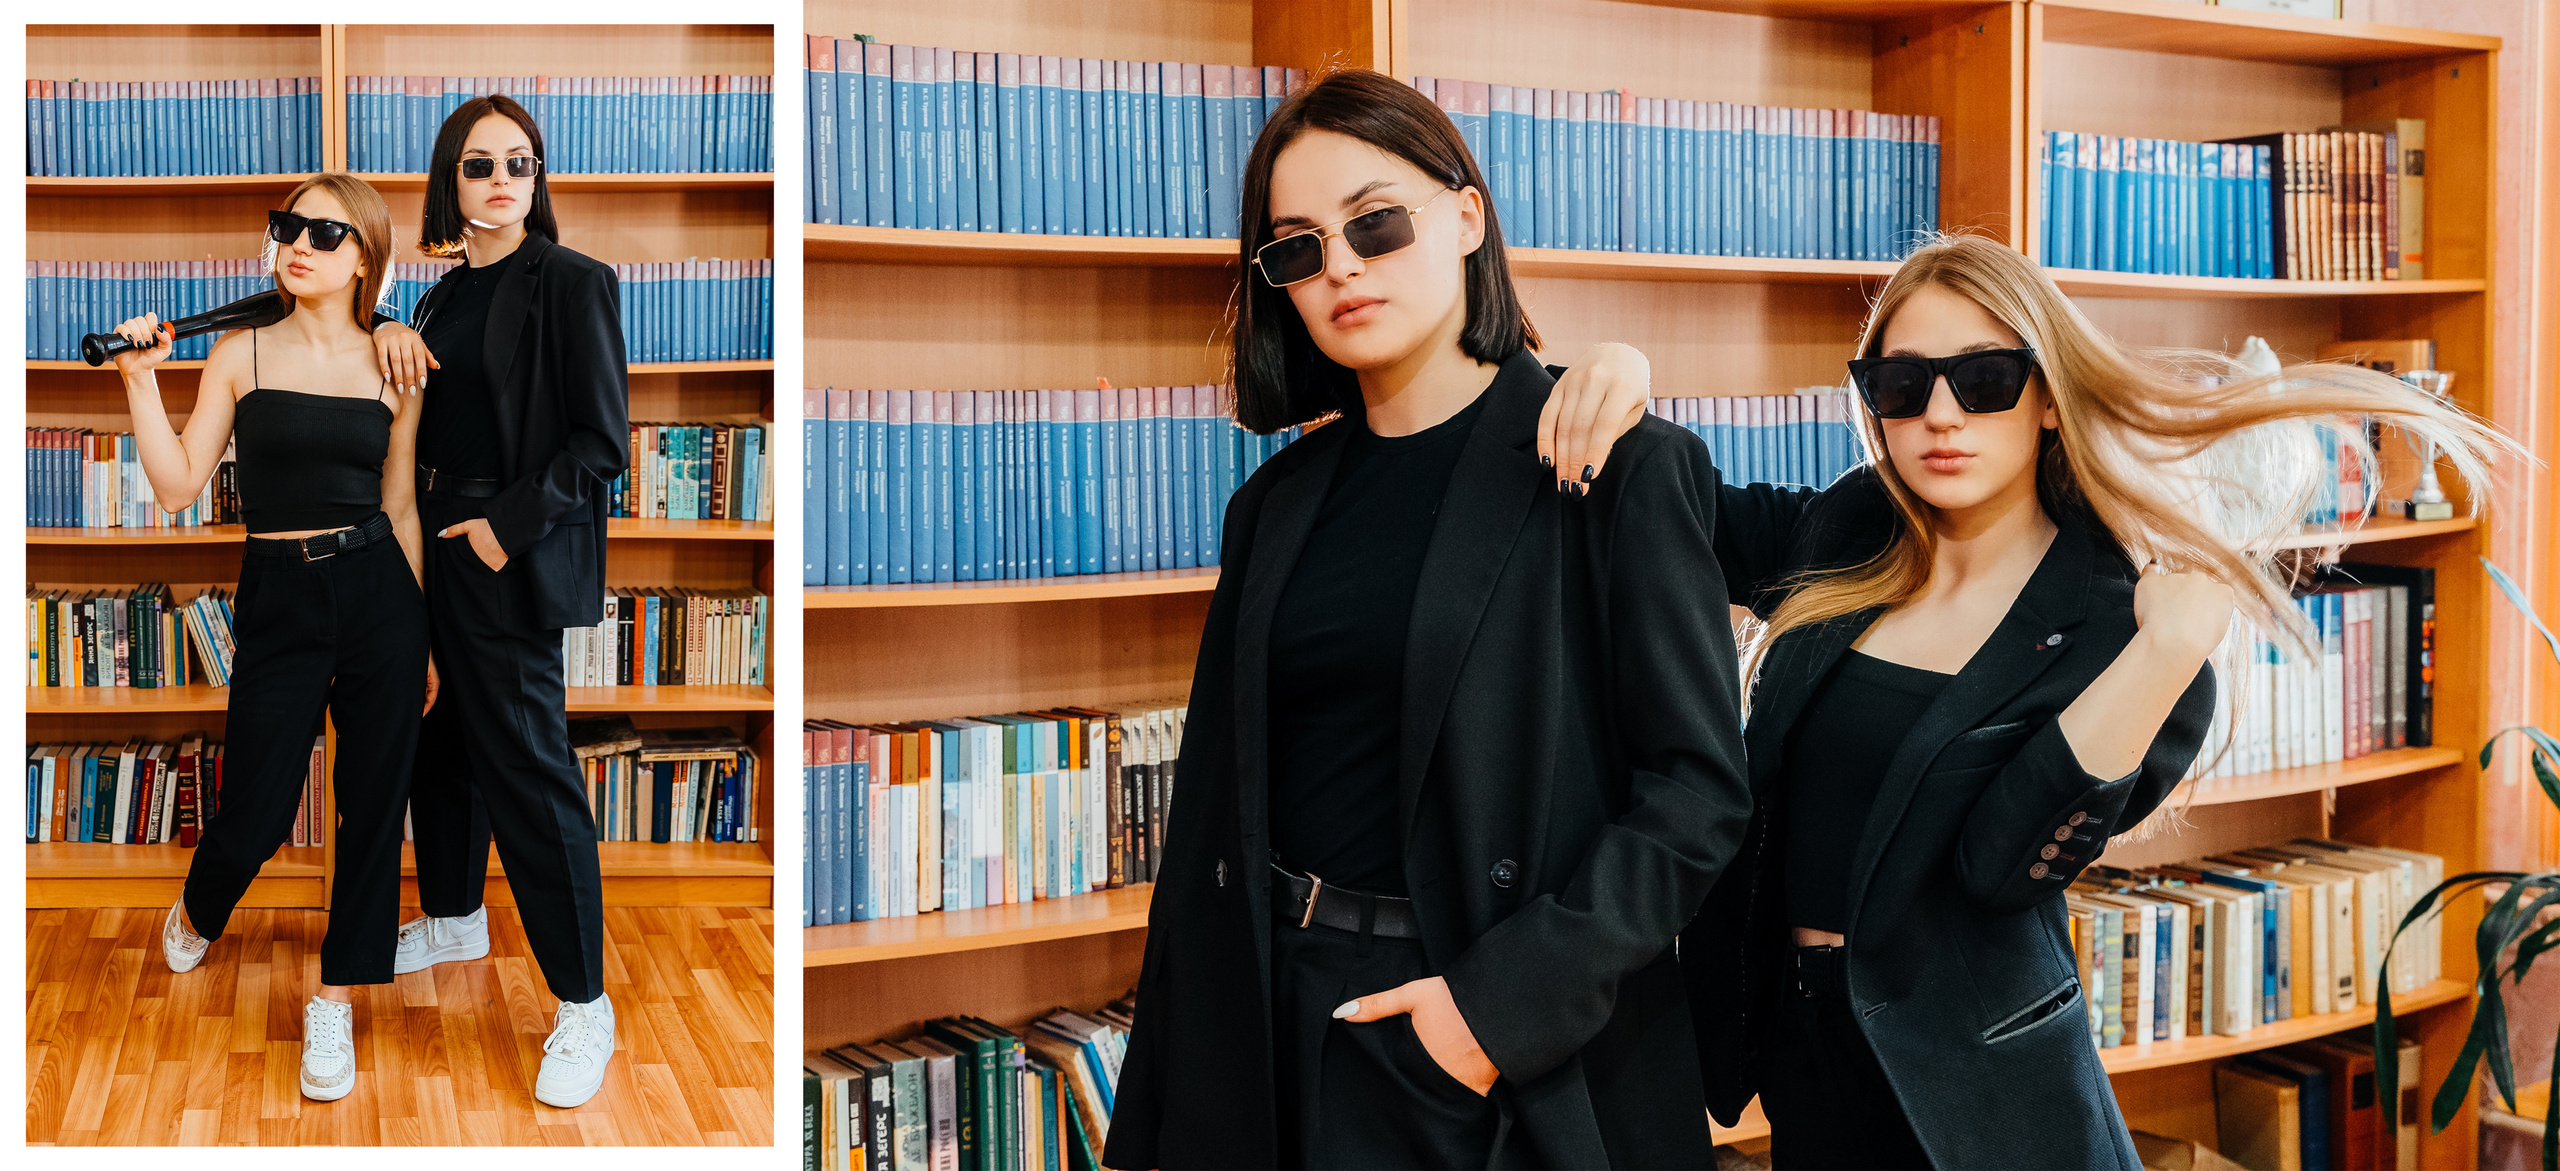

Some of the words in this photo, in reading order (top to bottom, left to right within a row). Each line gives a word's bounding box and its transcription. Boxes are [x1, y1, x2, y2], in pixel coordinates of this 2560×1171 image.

[606, 627, 614, 682] ЛЕРМОНТОВ
[1135, 773, 1144, 823] ДОСТОЕВСКИЙ
[908, 1073, 920, 1142] БРАЖЕЛОН
[876, 1113, 888, 1158] ЗЕГЕРС
